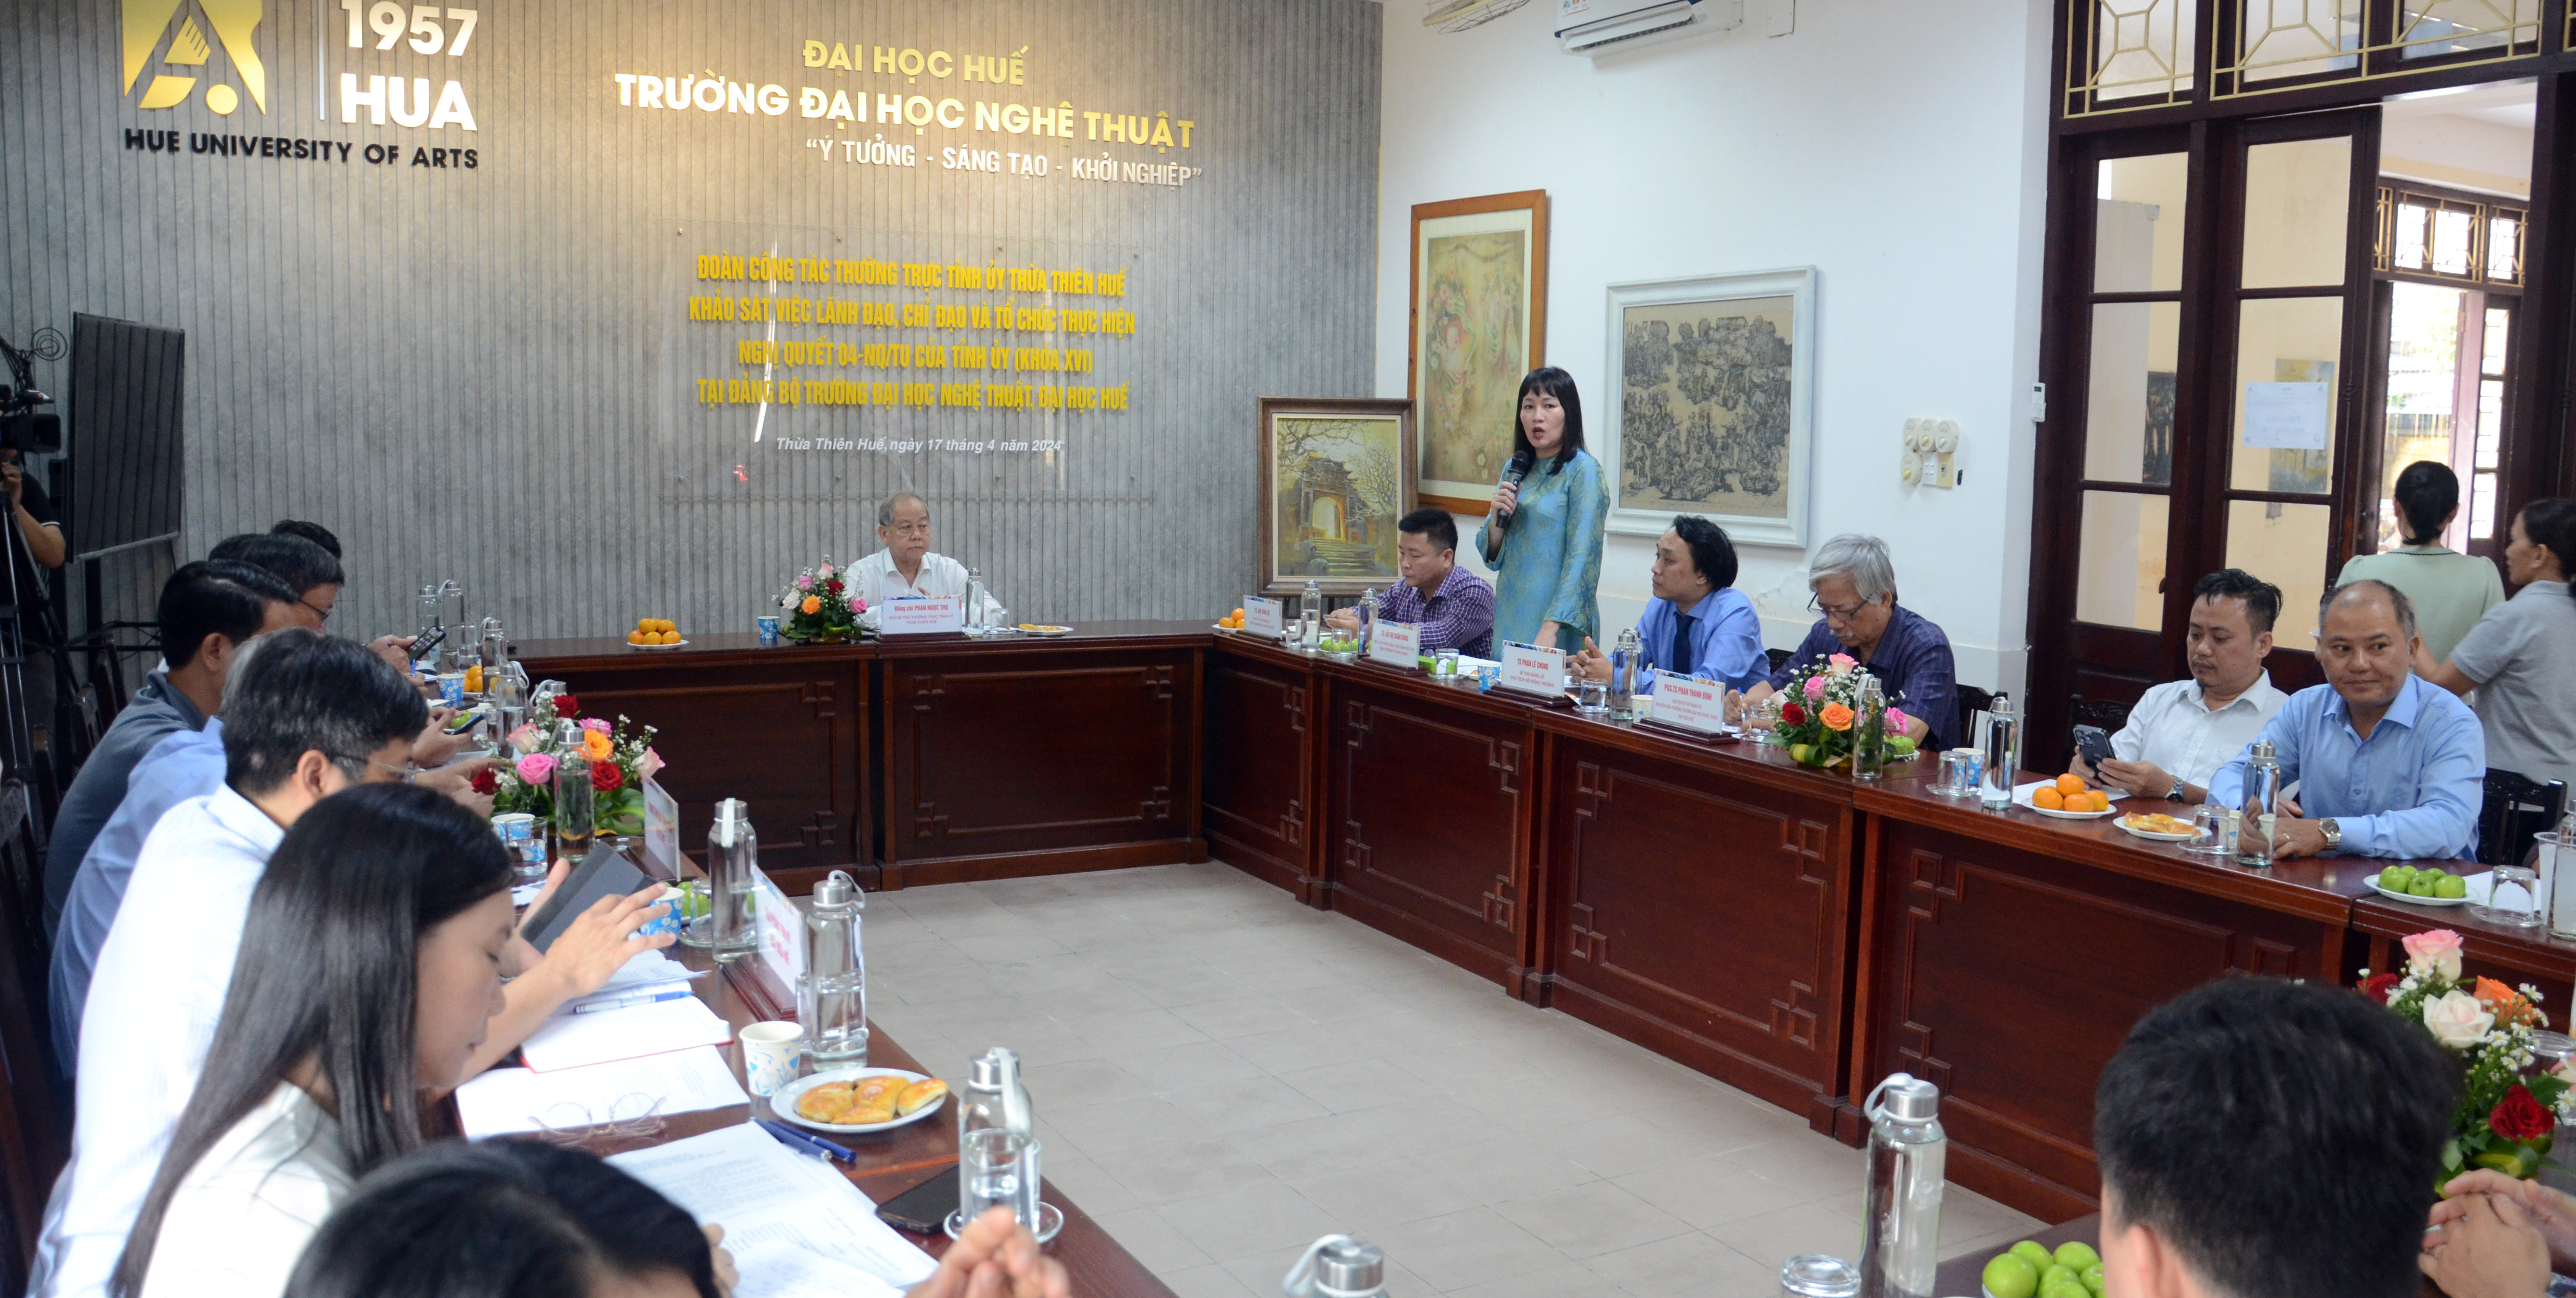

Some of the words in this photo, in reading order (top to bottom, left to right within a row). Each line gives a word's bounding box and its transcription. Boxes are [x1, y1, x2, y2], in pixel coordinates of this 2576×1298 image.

[342, 0, 477, 56] 1957
[802, 40, 862, 77] ĐẠI
[873, 45, 953, 84] HỌC
[964, 45, 1028, 85] HUẾ
[340, 73, 477, 131] HUA
[614, 68, 789, 116] TRƯỜNG
[799, 87, 867, 129] ĐẠI
[877, 92, 965, 135] HỌC
[1084, 110, 1194, 153] THUẬT
[125, 128, 180, 153] HUE
[190, 132, 353, 163] UNIVERSITY
[365, 143, 399, 165] OF
[411, 146, 478, 169] ARTS
[841, 133, 915, 167] TƯỞNG
[942, 144, 1000, 173] SÁNG
[1007, 153, 1048, 180] TẠO
[1072, 152, 1118, 182] KHỞI
[697, 250, 744, 280] ĐOÀN
[749, 252, 794, 282] CÔNG
[799, 253, 830, 283] TÁC
[835, 255, 898, 285] THƯỜNG
[902, 262, 942, 292] TRỰC
[947, 259, 981, 289] TỈNH
[986, 260, 1005, 290] ỦY
[1009, 263, 1047, 292] THỪA
[1051, 267, 1093, 294] THIÊN
[1098, 267, 1128, 296] HUẾ
[689, 288, 734, 320] KHẢO
[740, 293, 770, 321] SÁT
[776, 294, 811, 327] VIỆC
[816, 296, 858, 324] LÃNH
[862, 302, 899, 330] ĐẠO,
[903, 297, 929, 328] CHỈ
[935, 305, 967, 332] ĐẠO
[971, 301, 991, 329] VÀ
[995, 297, 1015, 329] TỔ
[1061, 308, 1097, 337] THỰC
[1101, 307, 1135, 338] HIỆN
[739, 339, 778, 369] NGHỊ
[784, 334, 834, 367] QUYẾT
[915, 337, 946, 368] CỦA
[951, 338, 986, 368] TỈNH
[991, 339, 1010, 369] ỦY
[1015, 343, 1060, 372] (KHÓA
[1064, 349, 1092, 374] XVI)
[697, 379, 723, 408] TẠI
[729, 372, 774, 404] ĐẢNG
[779, 376, 800, 409] BỘ
[804, 375, 867, 405] TRƯỜNG
[872, 382, 898, 410] ĐẠI
[903, 383, 934, 410] HỌC
[940, 379, 981, 411] NGHỆ
[986, 380, 1034, 412] THUẬT,
[1038, 386, 1063, 412] ĐẠI
[1067, 386, 1096, 413] HỌC
[1100, 380, 1130, 409] HUẾ
[777, 436, 810, 450] Thừa
[815, 437, 853, 450] Thiên
[857, 436, 888, 452] Huế,
[890, 439, 923, 454] ngày
[927, 439, 942, 450] 17
[946, 438, 983, 454] tháng
[987, 439, 994, 450] 4
[1000, 439, 1028, 451] năm
[1031, 440, 1061, 451] 2024
